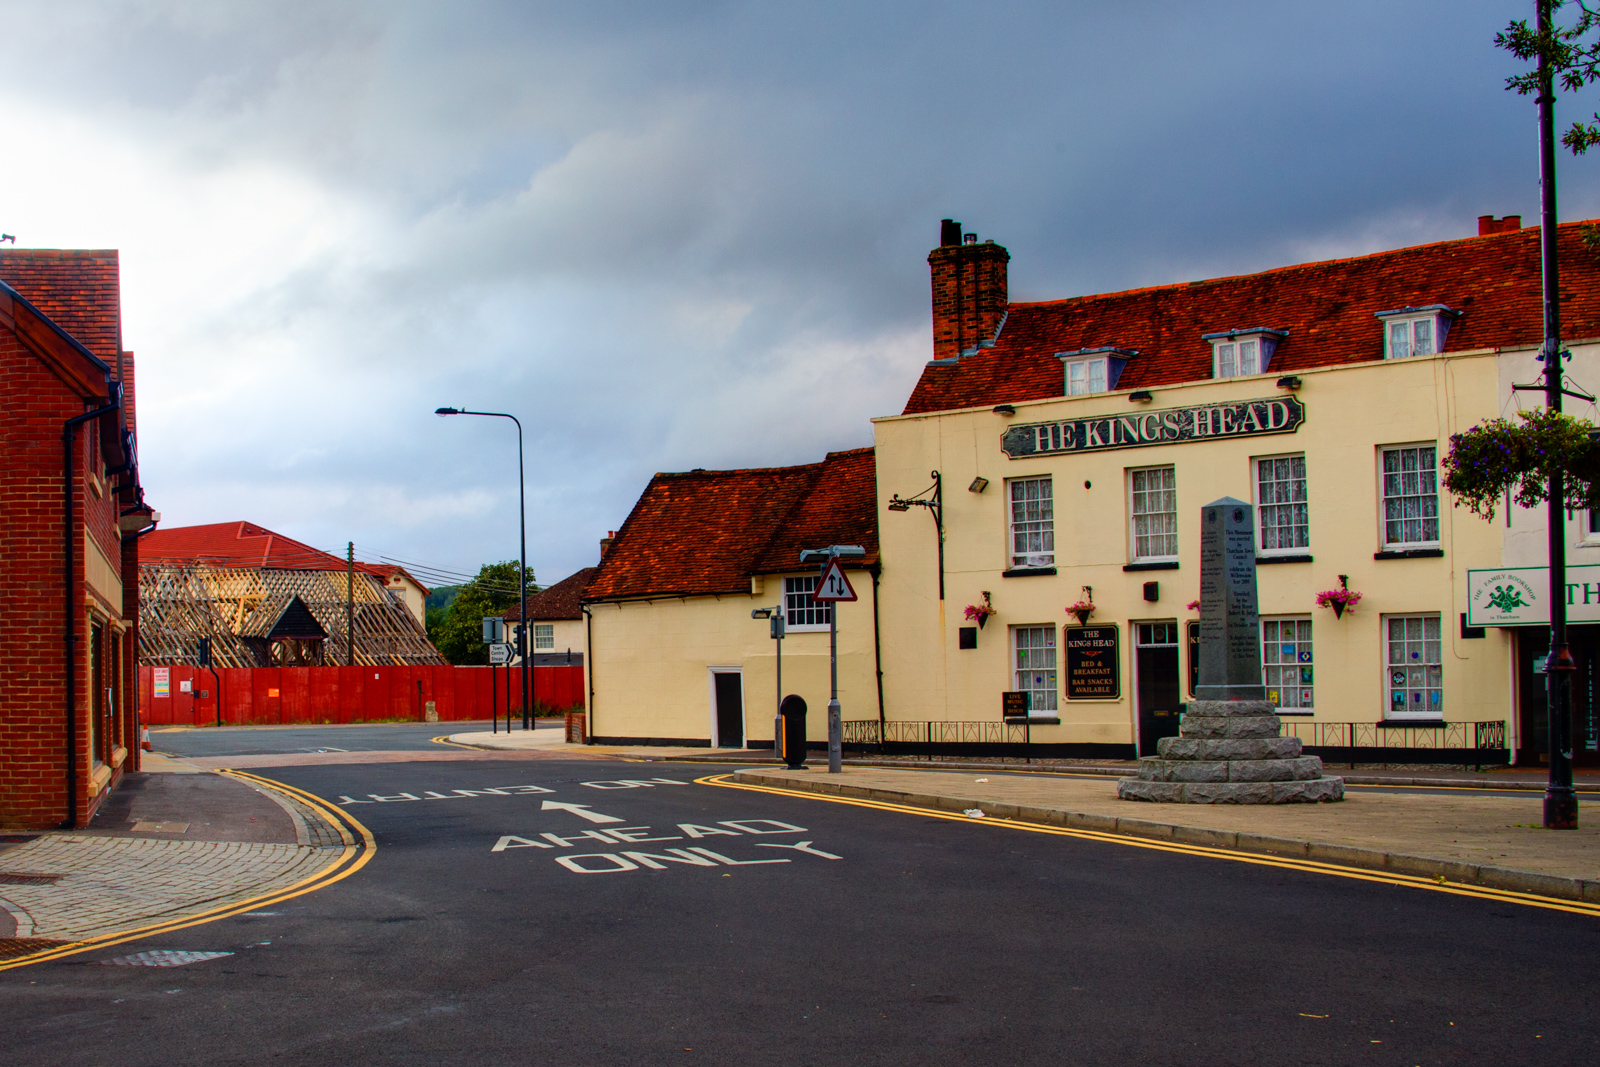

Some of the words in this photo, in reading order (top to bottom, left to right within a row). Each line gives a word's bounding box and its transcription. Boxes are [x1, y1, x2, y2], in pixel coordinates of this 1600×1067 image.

[1083, 411, 1181, 448] KINGS
[1191, 400, 1290, 438] HEAD
[1474, 588, 1483, 600] THE
[1484, 574, 1506, 587] FAMILY
[1508, 574, 1536, 600] BOOKSHOP
[491, 819, 809, 852] AHEAD
[554, 840, 844, 874] ONLY
